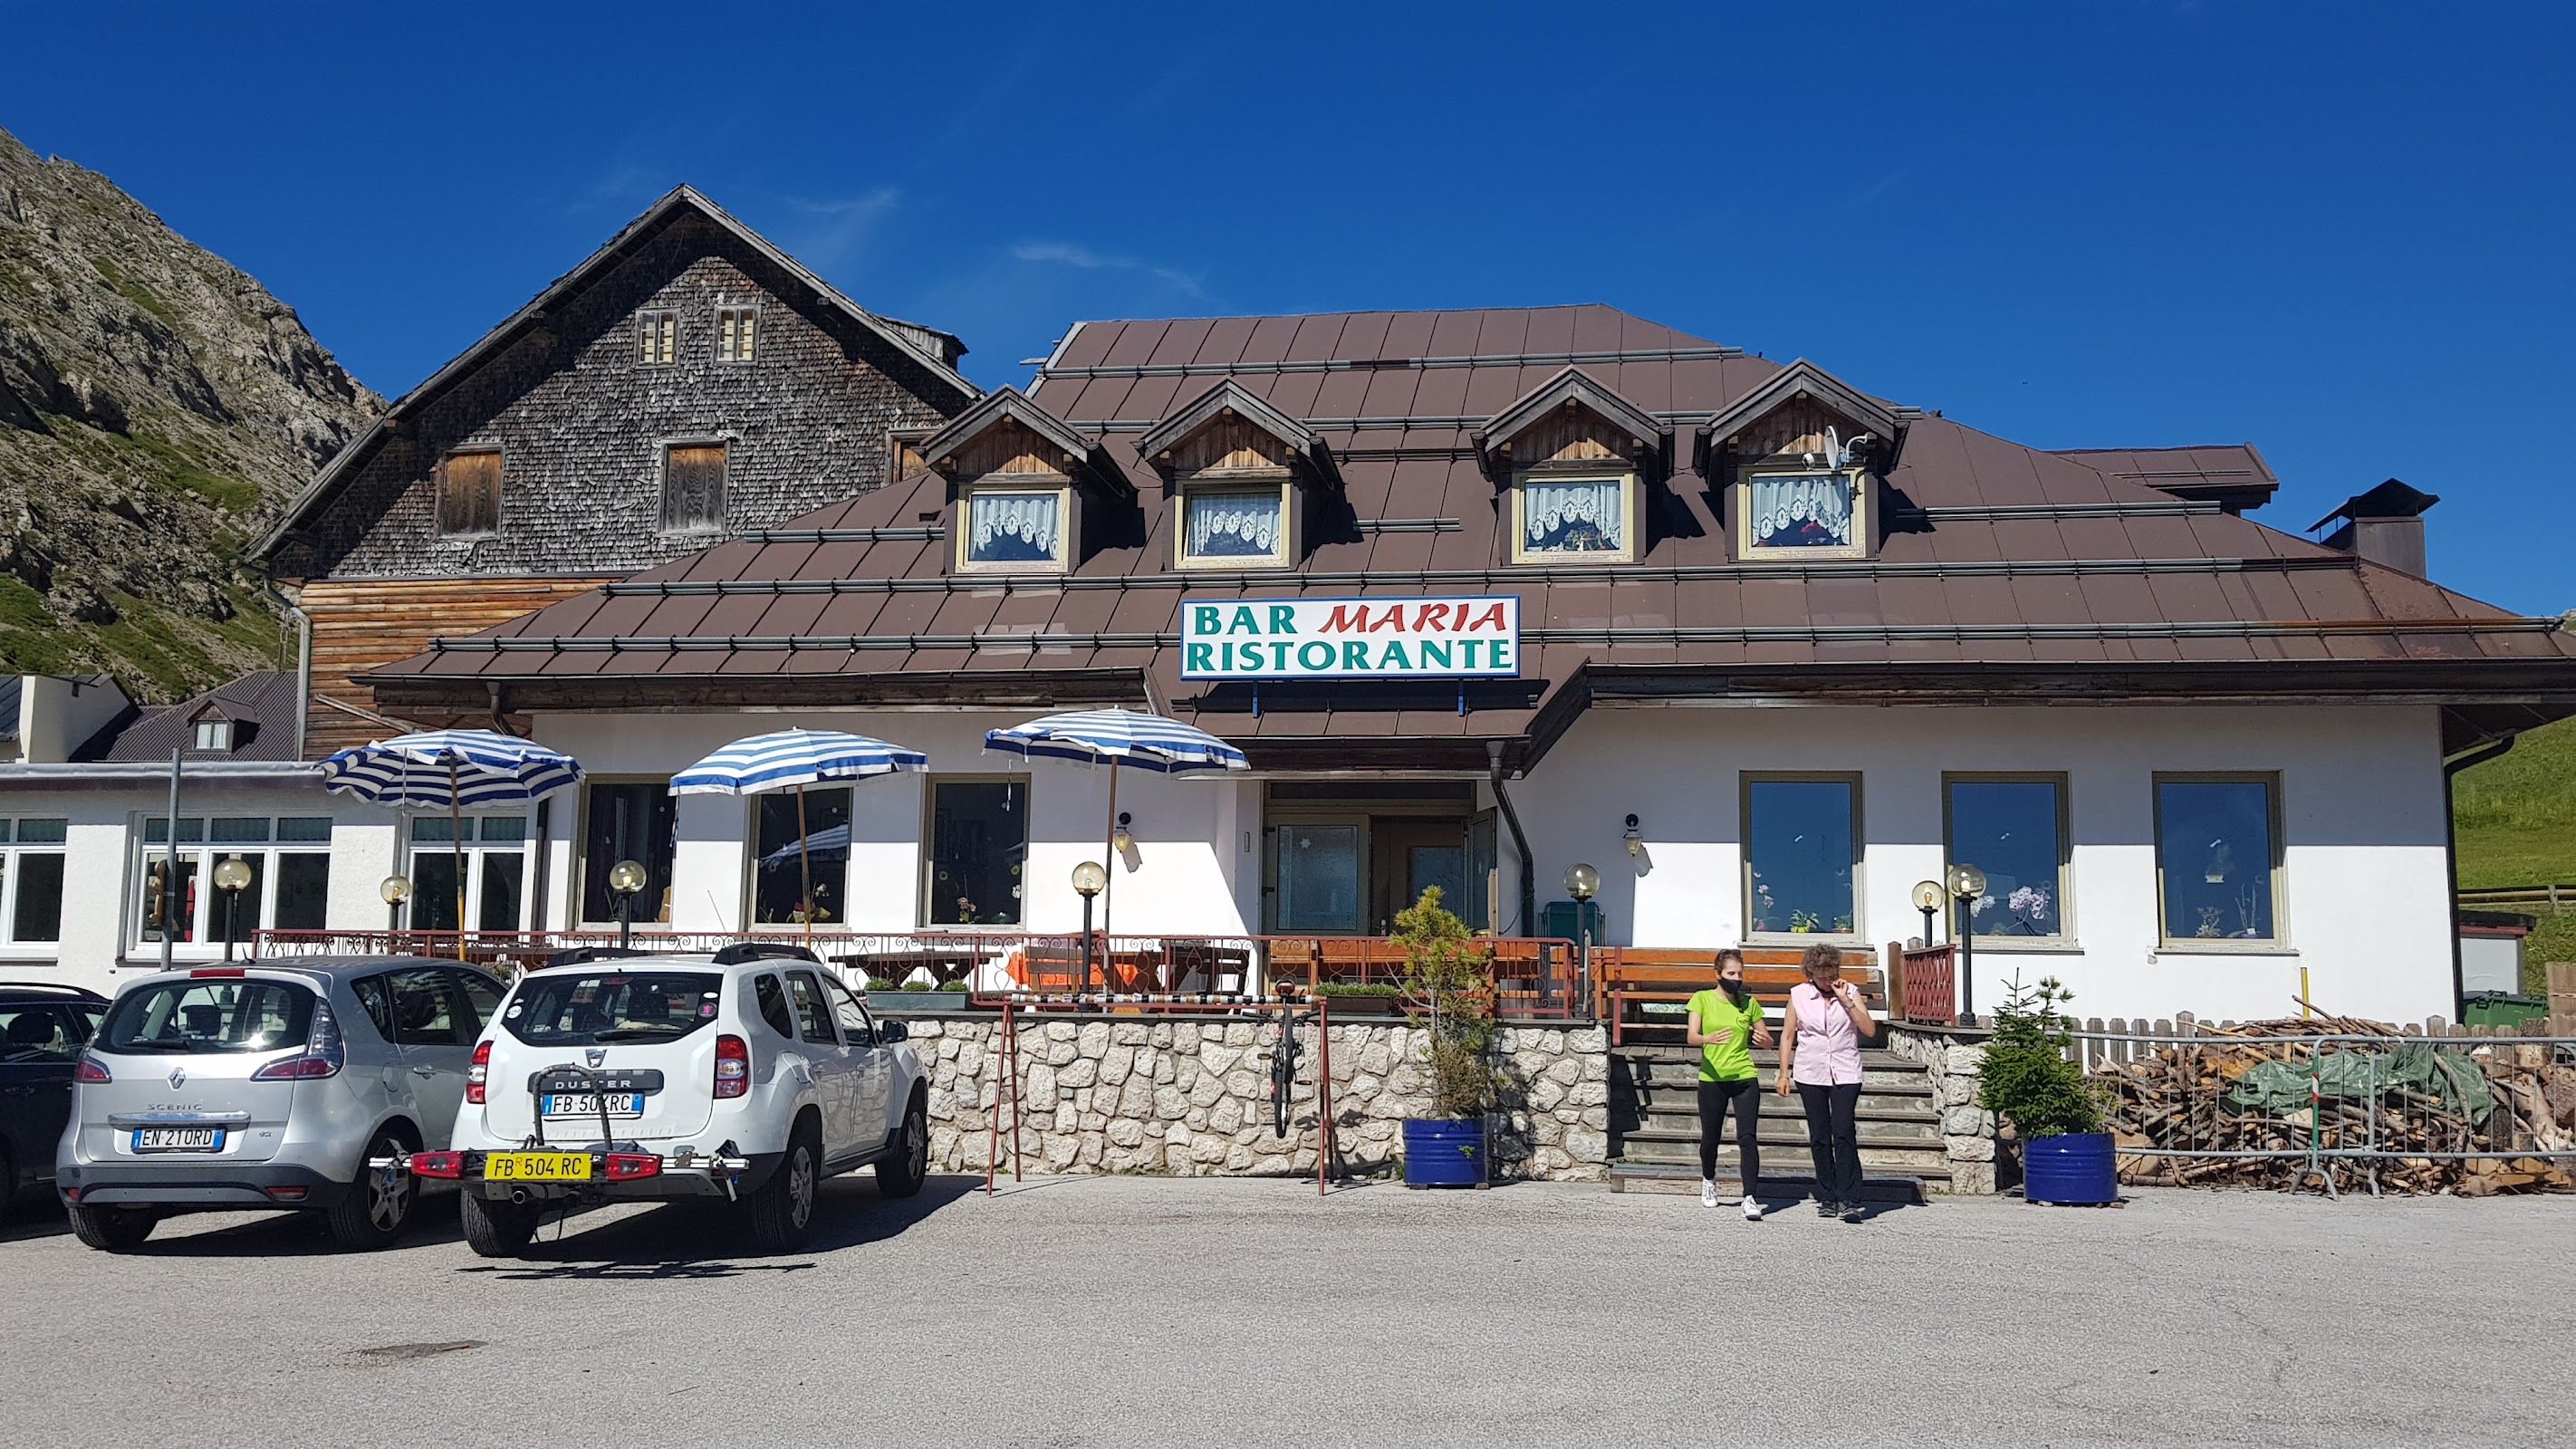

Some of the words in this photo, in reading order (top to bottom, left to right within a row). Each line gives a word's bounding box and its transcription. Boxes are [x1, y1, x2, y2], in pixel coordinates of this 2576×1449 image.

[1194, 605, 1299, 636] BAR
[1317, 602, 1508, 634] MARIA
[1186, 639, 1514, 672] RISTORANTE
[147, 1103, 203, 1111] SCENIC
[553, 1096, 573, 1112] FB
[142, 1129, 161, 1146] EN
[494, 1159, 514, 1176] FB
[524, 1157, 554, 1176] 504
[561, 1157, 582, 1176] RC
